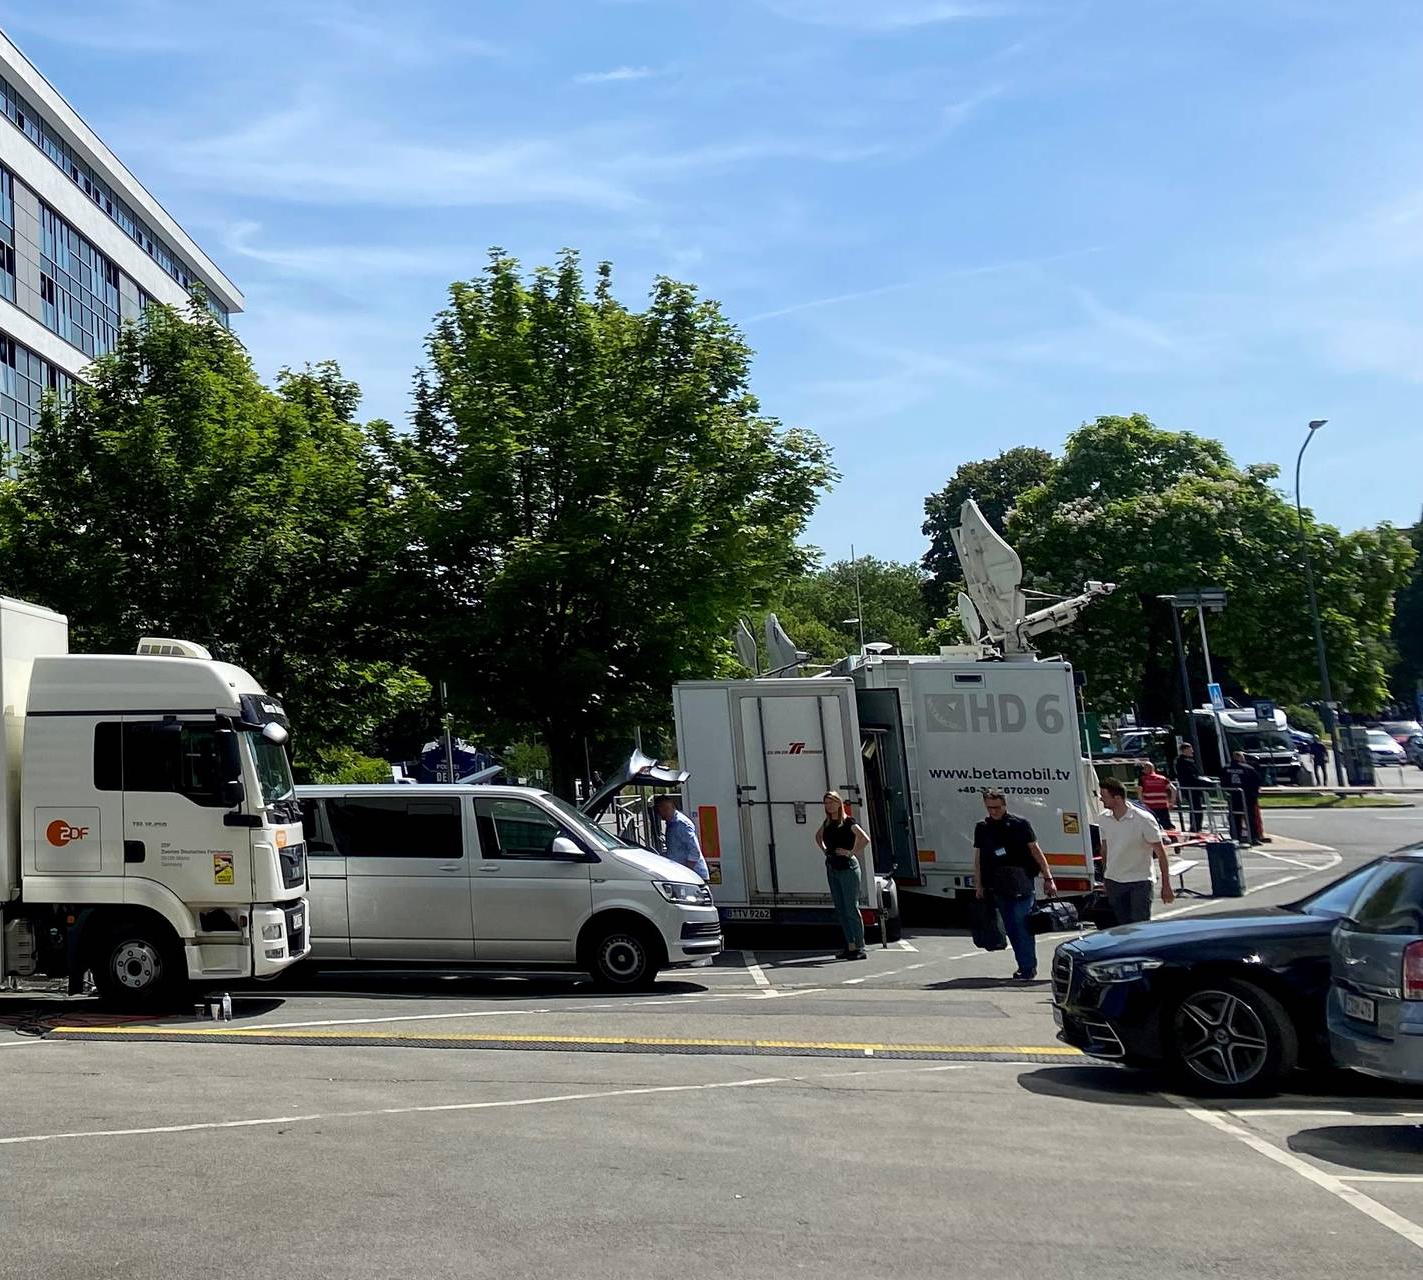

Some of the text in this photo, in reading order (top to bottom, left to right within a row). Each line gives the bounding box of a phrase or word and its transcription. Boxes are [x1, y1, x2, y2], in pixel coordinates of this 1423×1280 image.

[969, 694, 1027, 733] HD
[1036, 694, 1065, 734] 6
[929, 768, 1071, 781] www.betamobil.tv
[60, 827, 89, 840] ZDF
